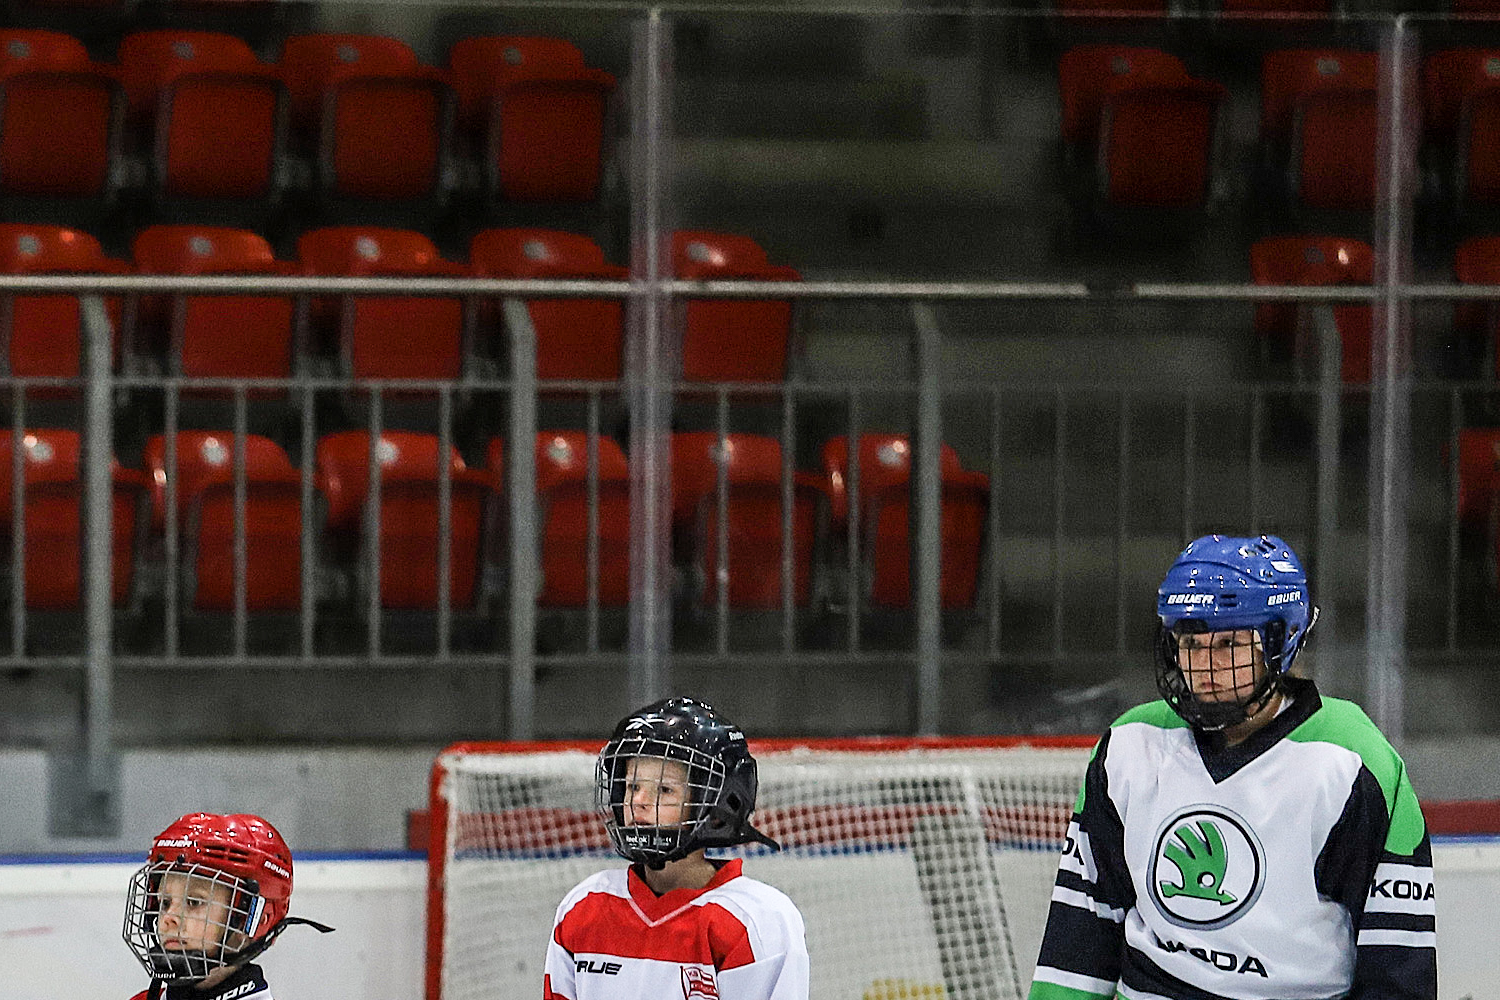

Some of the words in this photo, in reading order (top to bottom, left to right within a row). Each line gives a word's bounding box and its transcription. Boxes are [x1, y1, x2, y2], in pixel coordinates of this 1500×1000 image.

[1167, 594, 1216, 605] BAUER
[1267, 591, 1301, 606] BAUER
[156, 839, 193, 848] BAUER
[263, 860, 291, 879] BAUER
